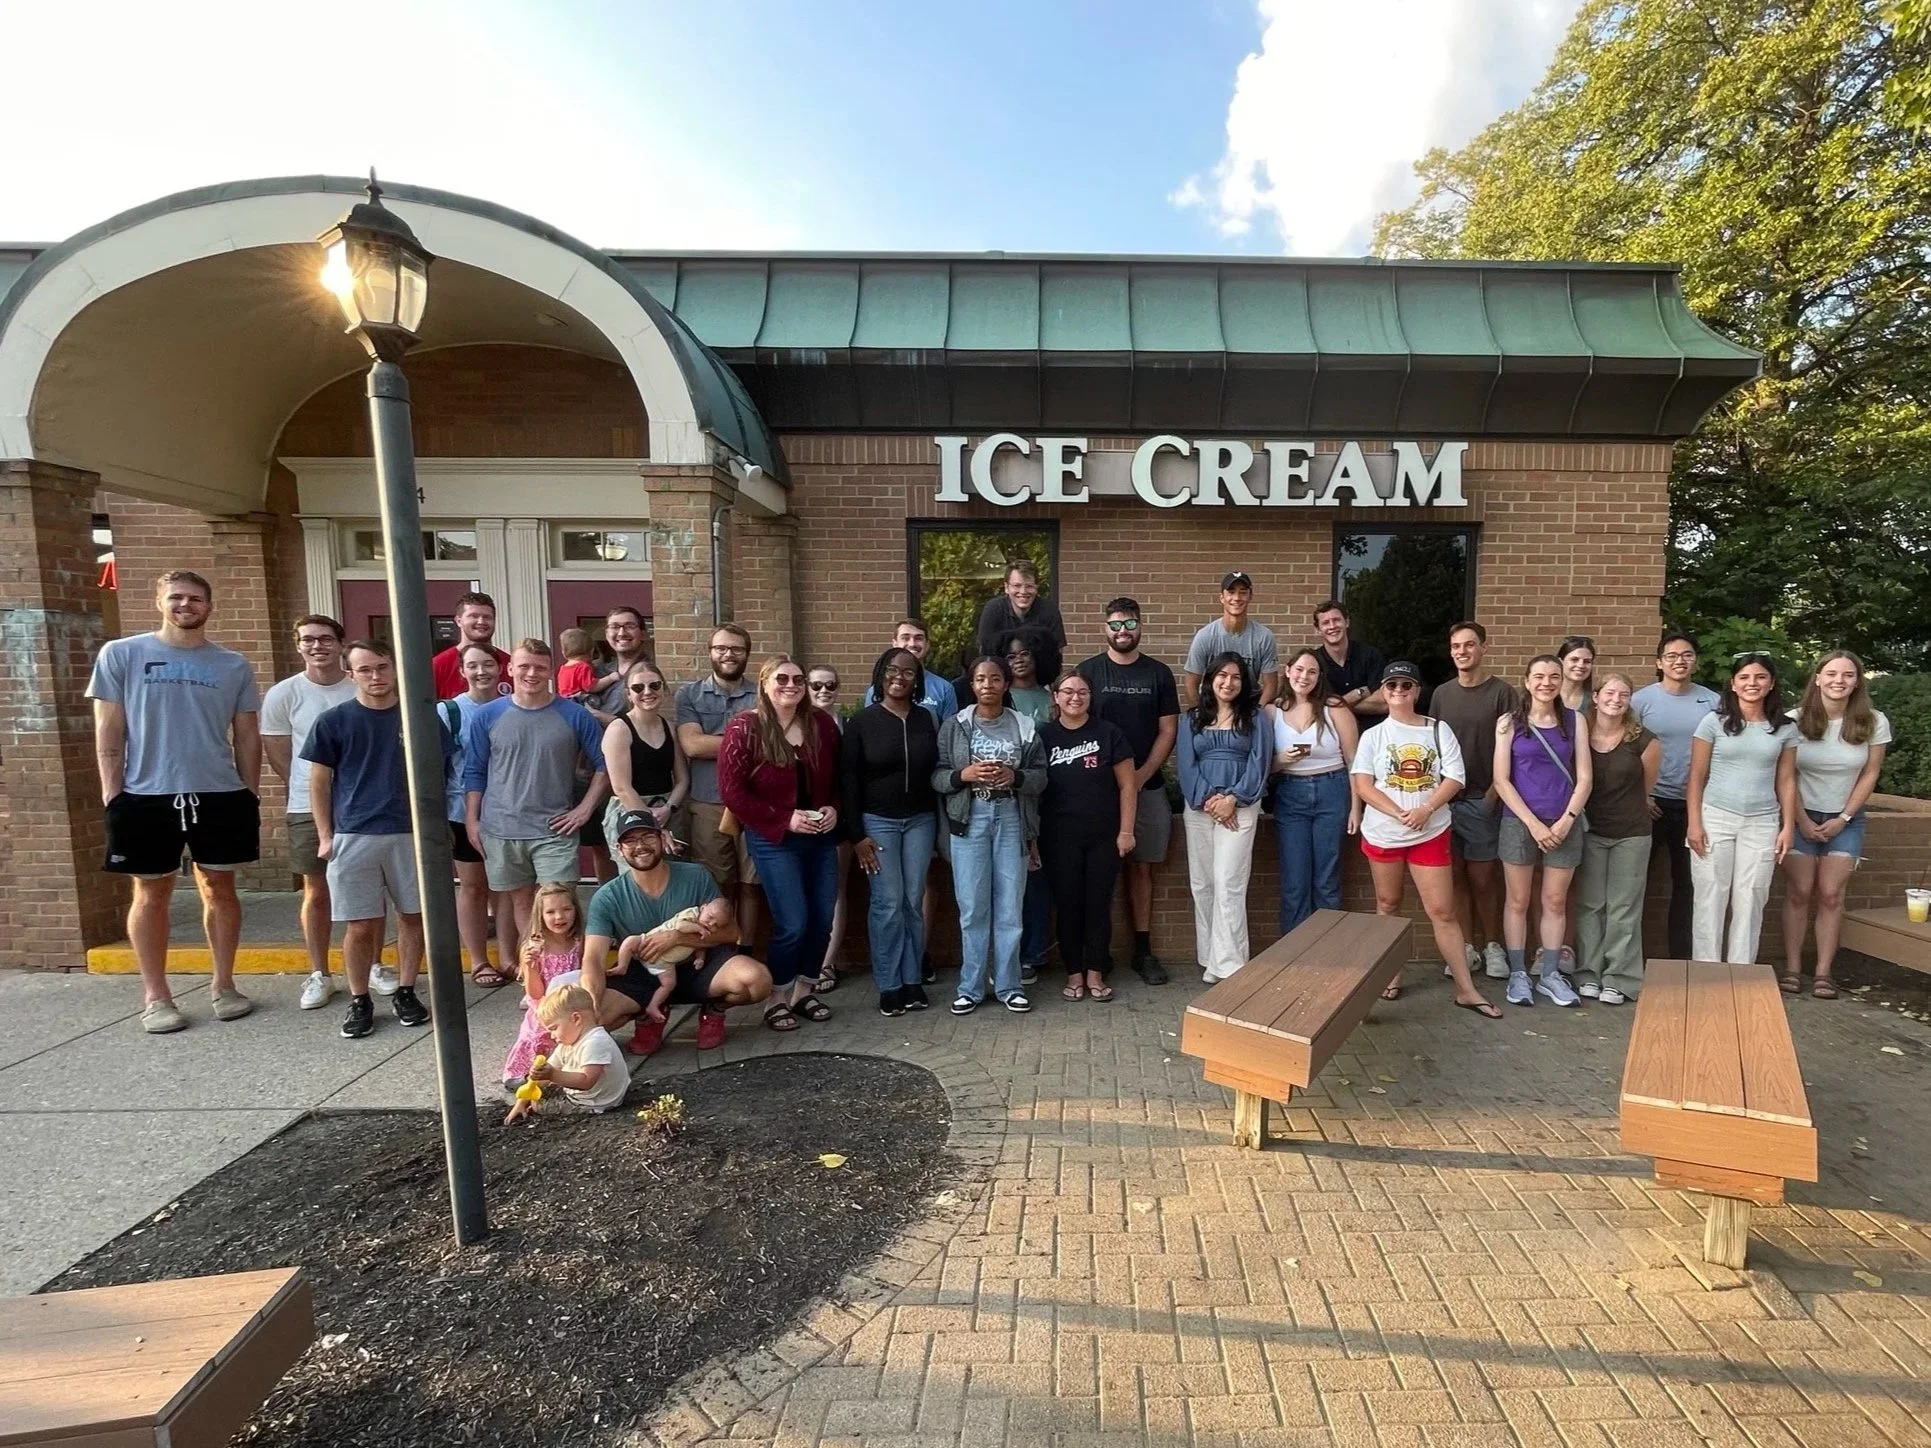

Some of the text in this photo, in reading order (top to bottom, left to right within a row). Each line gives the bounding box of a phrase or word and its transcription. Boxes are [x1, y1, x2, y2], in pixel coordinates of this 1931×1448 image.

[934, 433, 1469, 508] ICE CREAM
[144, 678, 219, 689] BASKETBALL
[1050, 740, 1100, 766] Penguins
